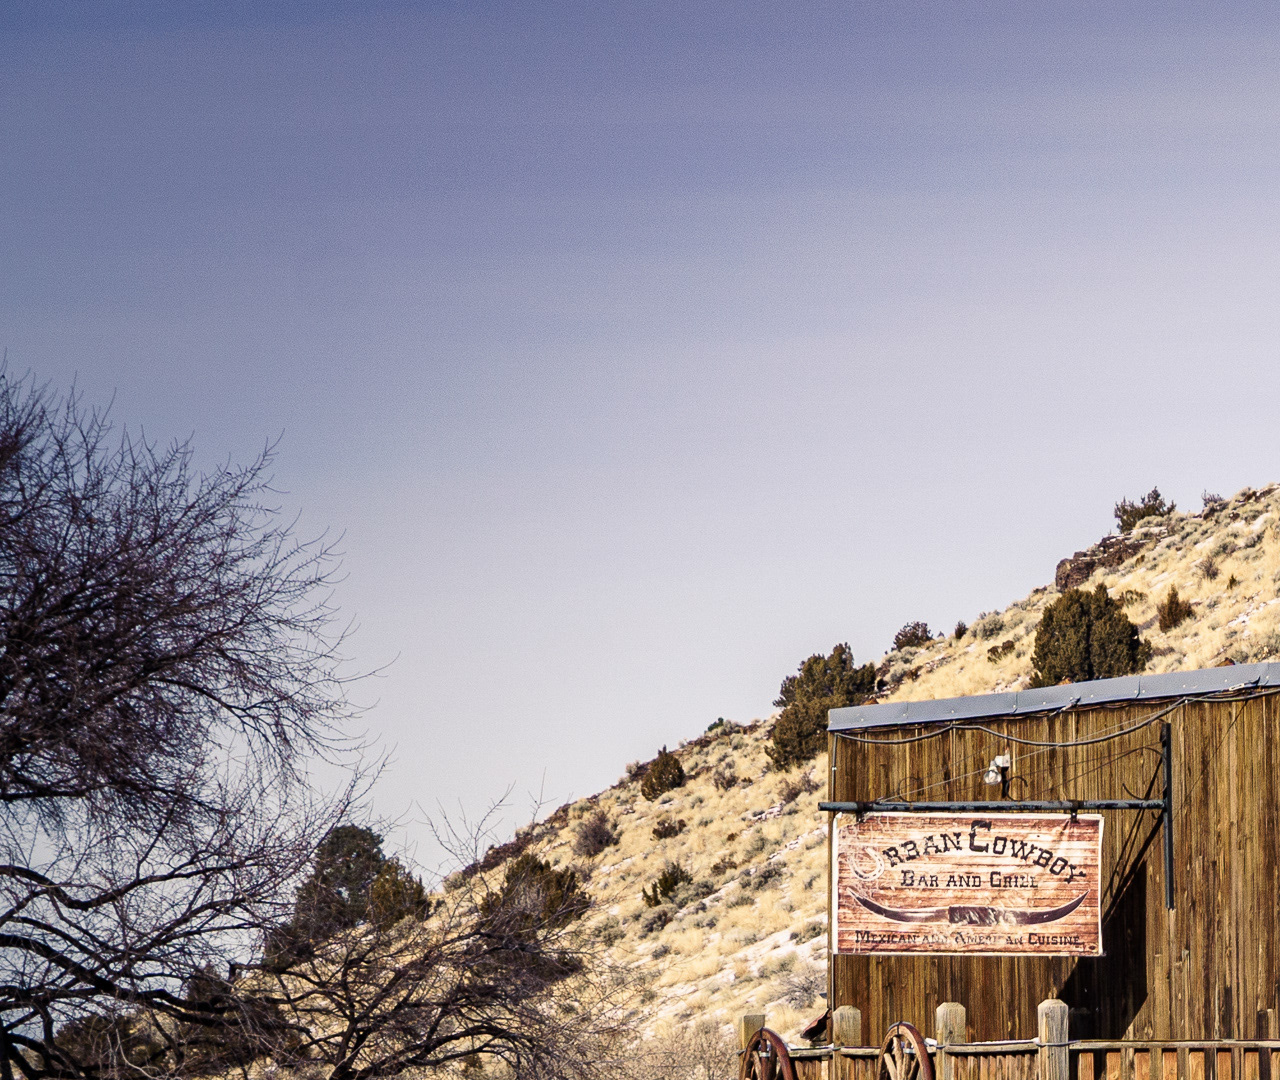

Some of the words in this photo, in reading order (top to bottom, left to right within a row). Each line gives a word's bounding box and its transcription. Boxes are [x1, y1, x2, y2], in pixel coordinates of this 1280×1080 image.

[968, 820, 1087, 884] COWBOY
[900, 869, 939, 887] BAR
[946, 873, 982, 888] AND
[989, 871, 1039, 888] GRILL
[855, 930, 917, 945] MEXICAN
[1028, 932, 1081, 946] CUISINE
